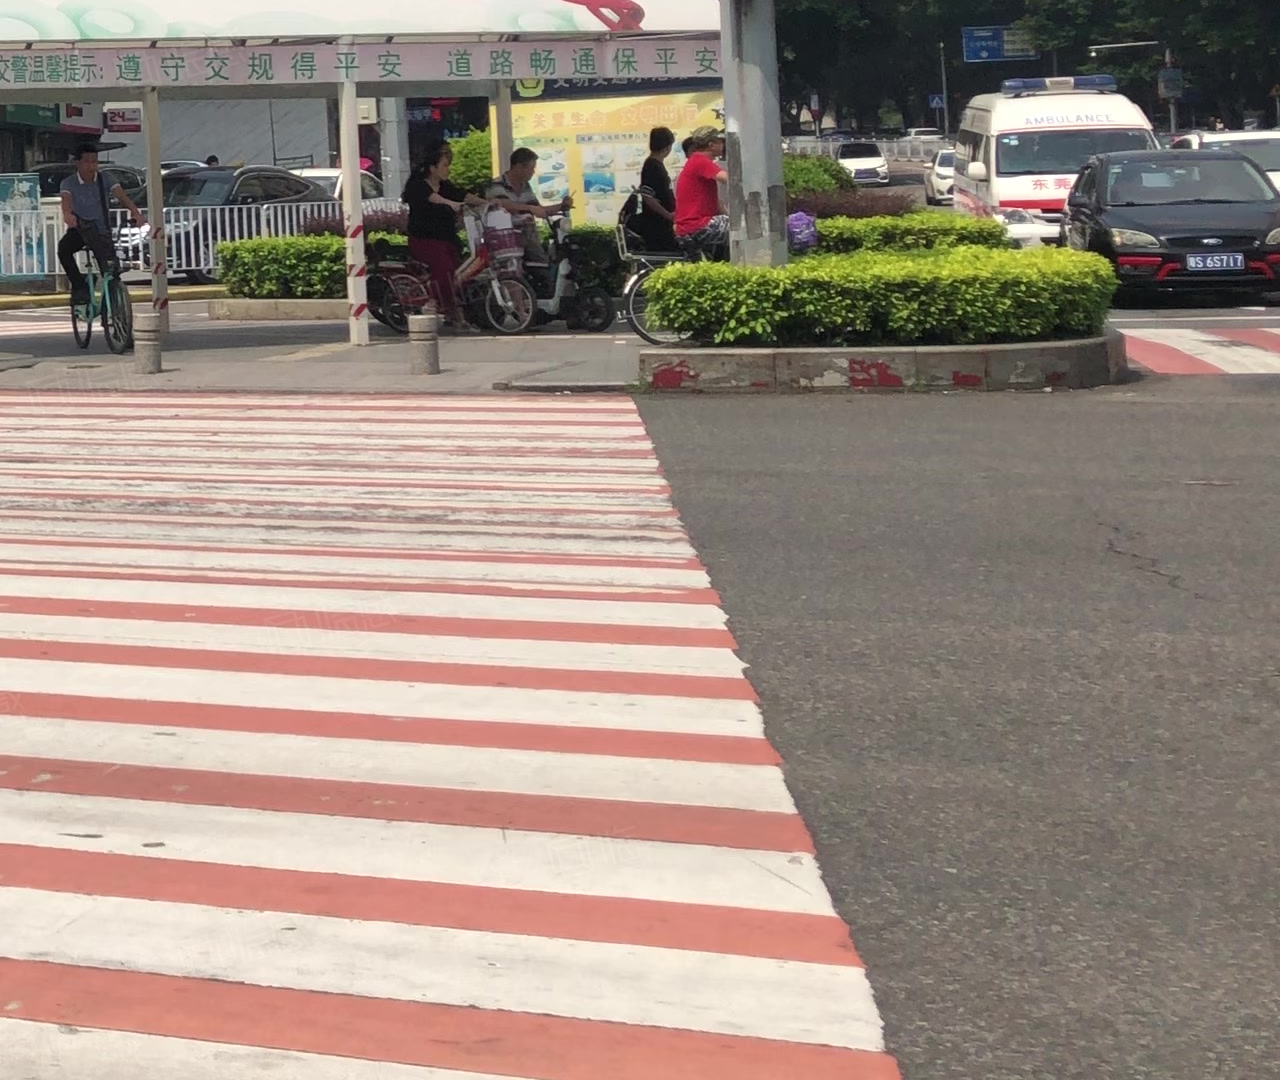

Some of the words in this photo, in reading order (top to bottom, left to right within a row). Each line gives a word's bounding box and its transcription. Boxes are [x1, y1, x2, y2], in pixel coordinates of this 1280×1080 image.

[116, 51, 403, 82] 遵守交规得平安
[447, 46, 719, 77] 道路畅通保平安
[1025, 113, 1115, 126] AMBULANCE
[1032, 177, 1073, 191] 东莞
